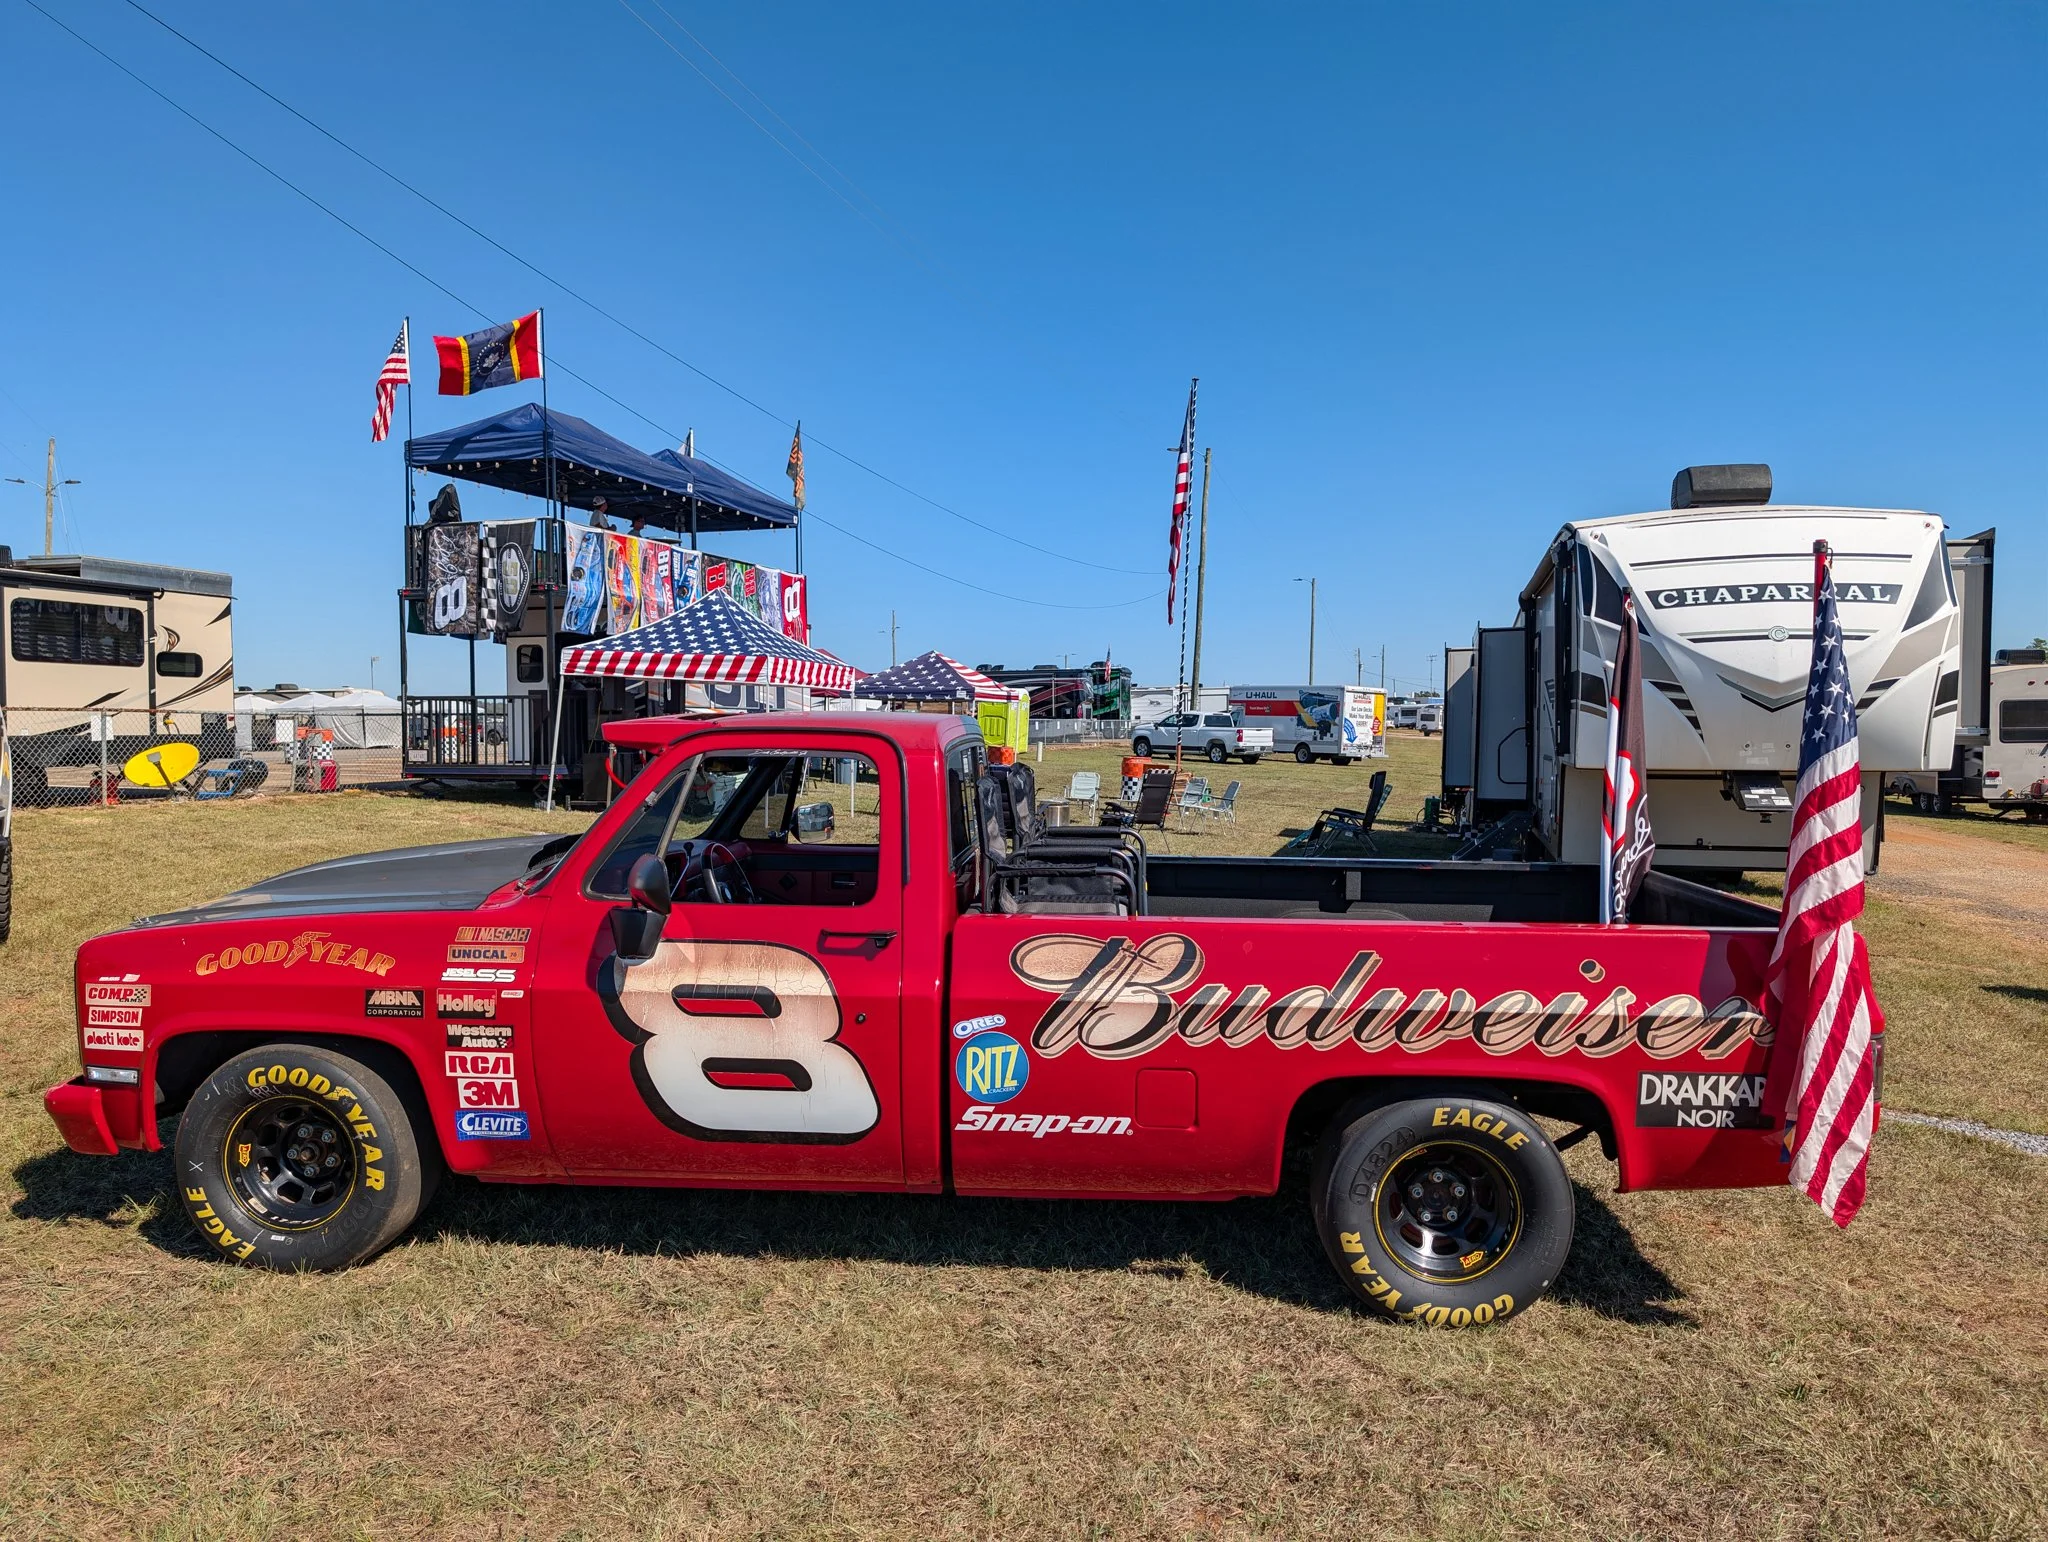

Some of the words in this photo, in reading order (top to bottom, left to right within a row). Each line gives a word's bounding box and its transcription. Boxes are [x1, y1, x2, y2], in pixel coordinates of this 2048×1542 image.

[658, 550, 670, 578] 88
[706, 562, 727, 593] 8
[744, 567, 757, 598] 88
[434, 576, 467, 631] 8
[784, 581, 801, 623] 8
[1657, 584, 1891, 608] CHAPARAL
[1245, 691, 1278, 699] U-HAUL
[478, 928, 528, 942] NASCAR
[452, 948, 508, 960] UNOCAL
[88, 987, 134, 1000] COMP
[367, 990, 421, 1006] MBNA
[1009, 932, 1776, 1060] Budweiser
[90, 1009, 140, 1024] SIMPSON
[437, 994, 496, 1018] Holley
[446, 1024, 513, 1037] Western
[954, 1015, 1006, 1038] OREO
[87, 1031, 115, 1046] plasti
[116, 1032, 140, 1047] kote
[461, 1036, 498, 1048] Auto
[596, 938, 882, 1146] 8
[448, 1055, 512, 1075] RCA
[965, 1044, 1020, 1095] RITZ
[463, 1080, 515, 1107] 3M
[1640, 1073, 1767, 1107] DRAKKAR
[461, 1112, 522, 1132] CLEVITE
[954, 1105, 1134, 1139] Snap-on
[1432, 1107, 1530, 1151] EAGLE
[1676, 1109, 1736, 1128] NOIR
[186, 1187, 257, 1260] EAGLE
